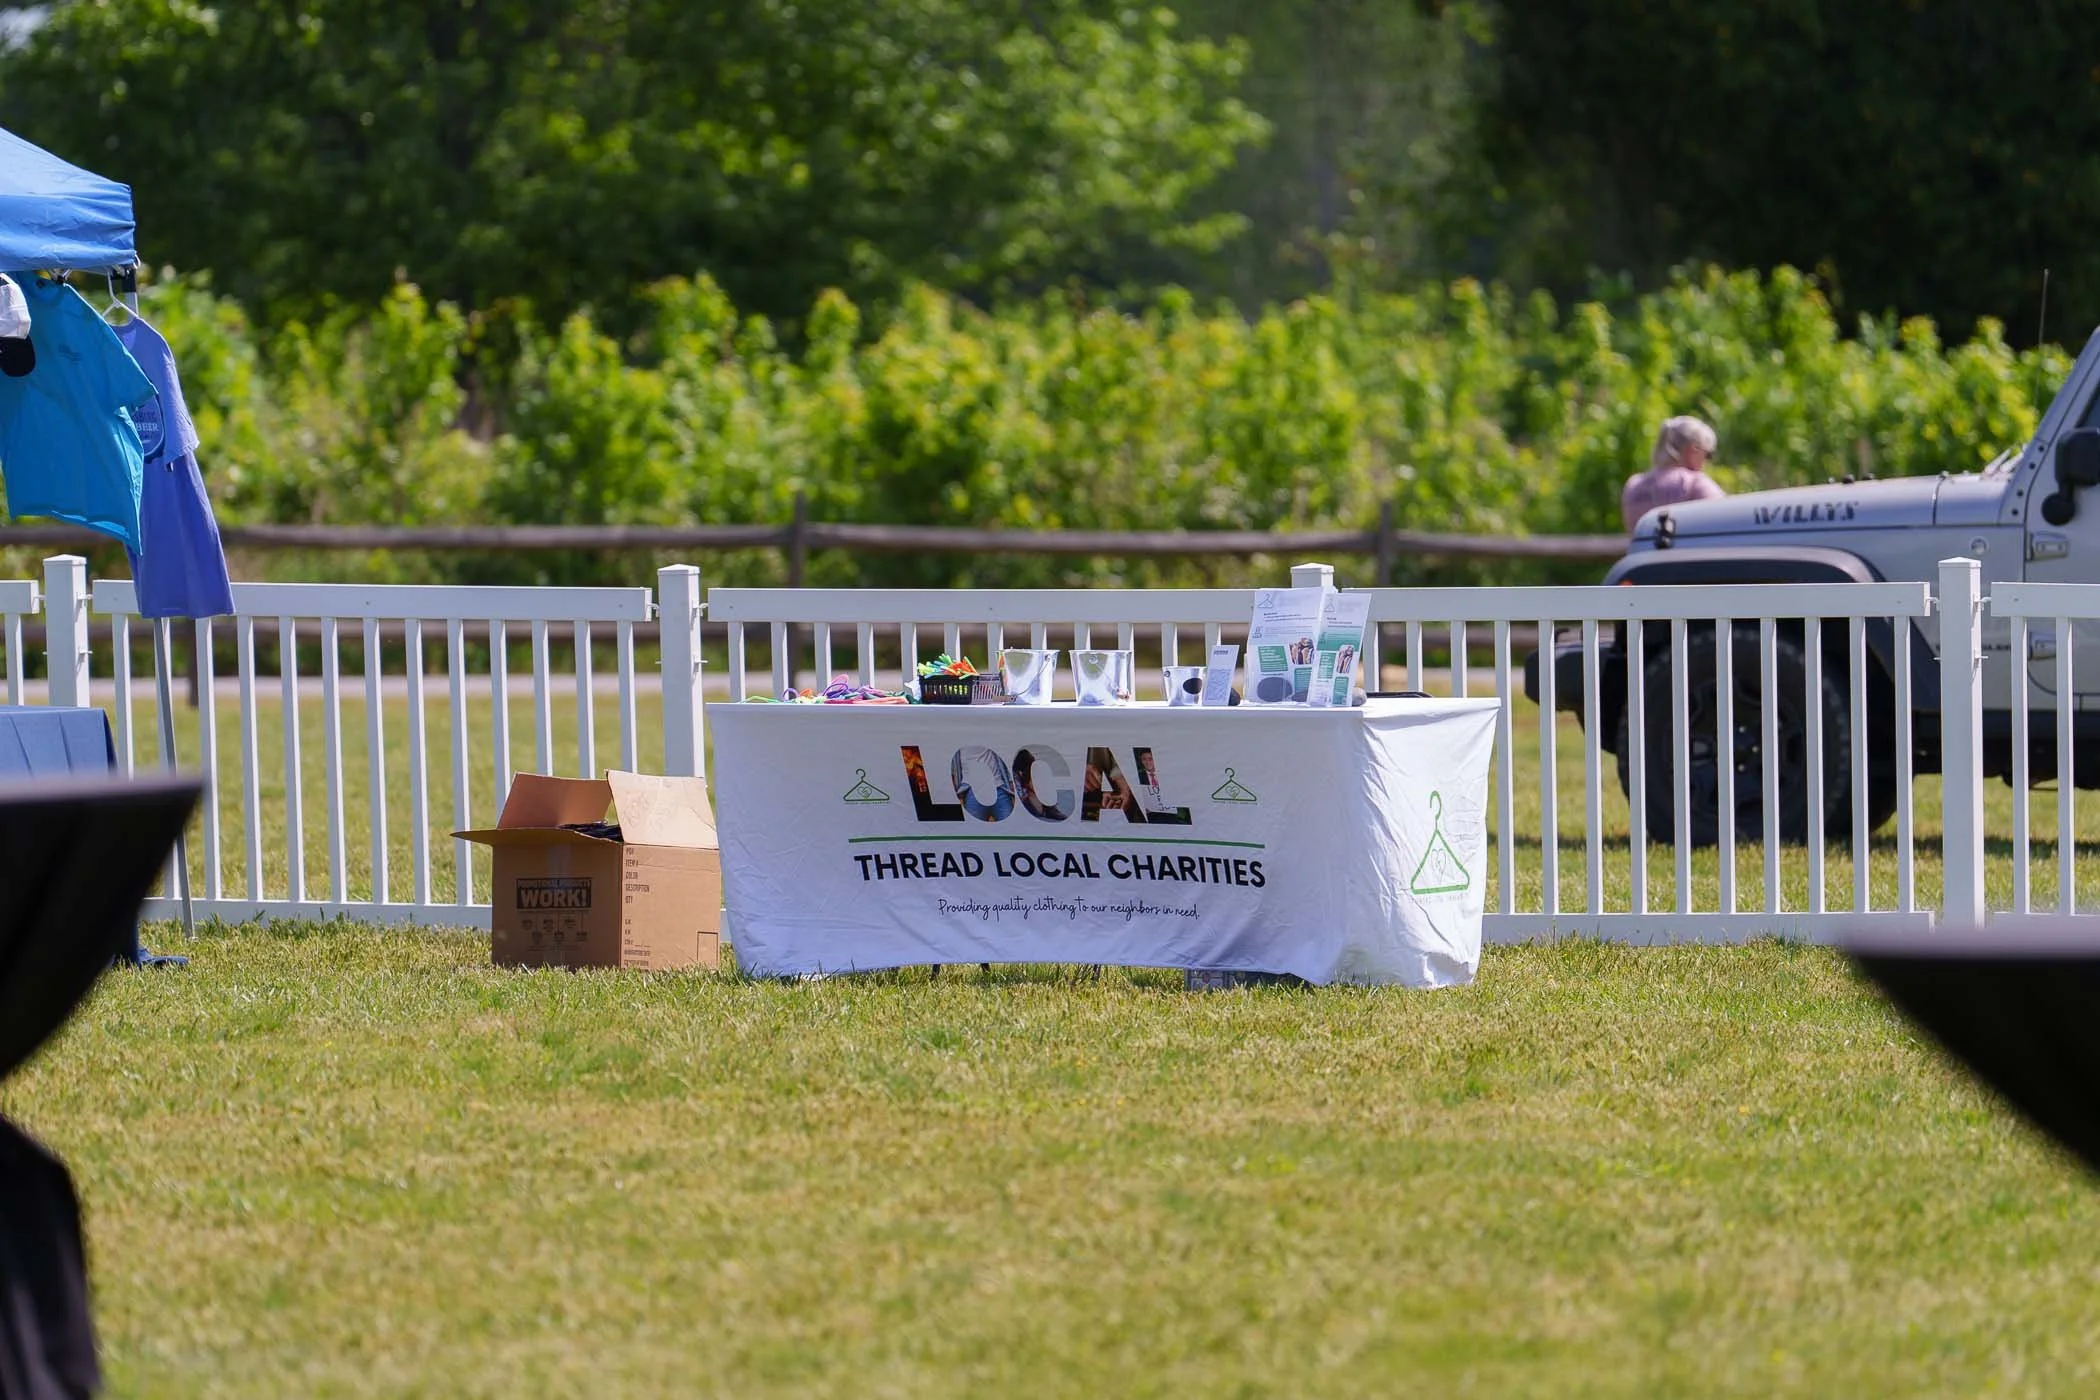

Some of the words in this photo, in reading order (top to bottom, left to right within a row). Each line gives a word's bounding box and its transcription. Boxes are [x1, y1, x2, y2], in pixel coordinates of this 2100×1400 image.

[135, 422, 159, 432] BEER
[1753, 501, 1859, 525] WILLYS
[900, 743, 1193, 826] LOCAL
[853, 851, 984, 882] THREAD
[993, 851, 1100, 880] LOCAL
[1107, 852, 1267, 889] CHARITIES
[520, 888, 588, 908] WORK!
[937, 897, 991, 921] Providing
[992, 895, 1031, 922] quality
[1033, 895, 1077, 920] clothing
[1072, 895, 1089, 913] to
[1091, 904, 1107, 913] our
[1110, 899, 1161, 922] neighbors
[1162, 904, 1174, 915] in
[1174, 903, 1200, 920] need.
